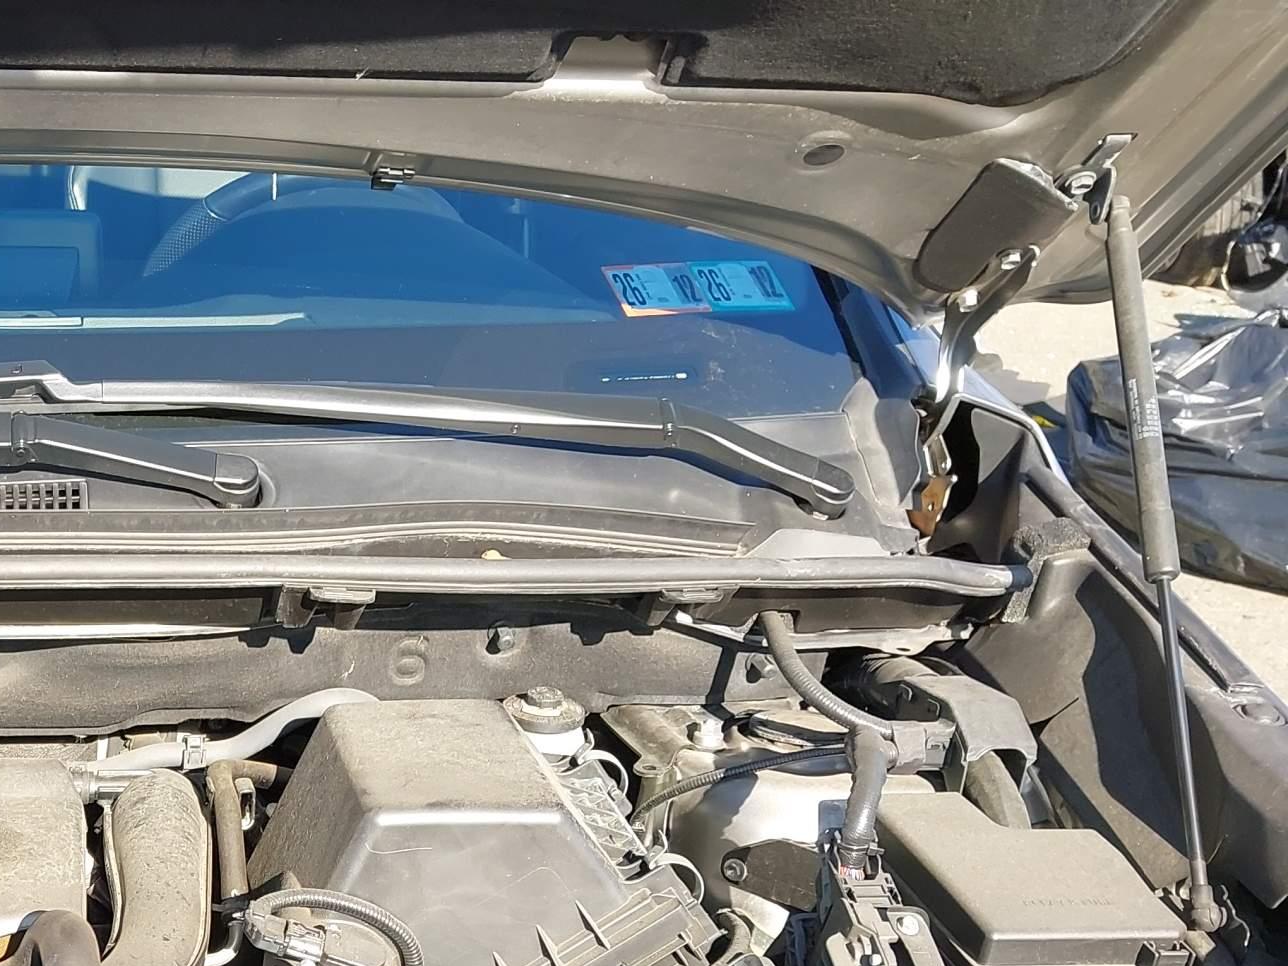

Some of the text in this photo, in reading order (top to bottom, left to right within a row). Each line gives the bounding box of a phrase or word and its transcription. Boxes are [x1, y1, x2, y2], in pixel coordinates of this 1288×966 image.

[612, 272, 647, 306] 26
[672, 274, 703, 302] 12
[697, 268, 732, 302] 26
[748, 265, 784, 298] 12
